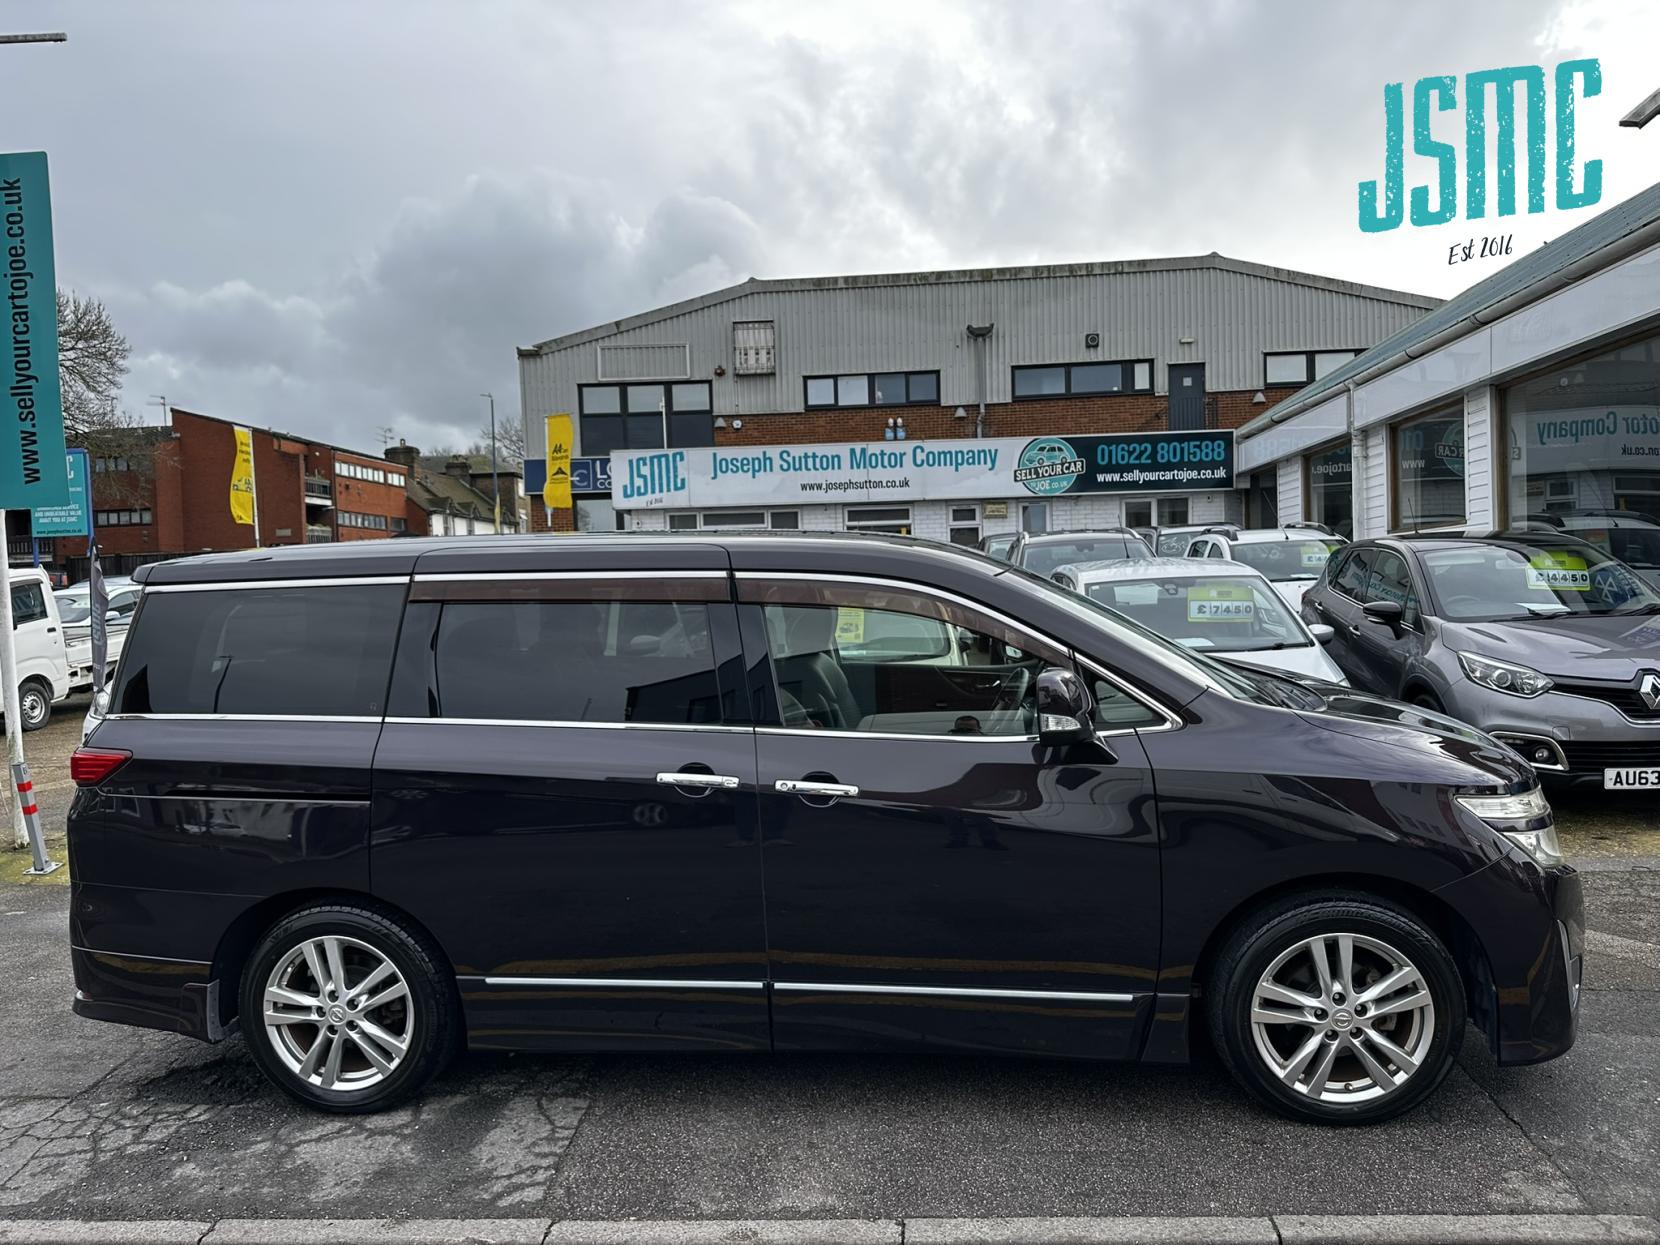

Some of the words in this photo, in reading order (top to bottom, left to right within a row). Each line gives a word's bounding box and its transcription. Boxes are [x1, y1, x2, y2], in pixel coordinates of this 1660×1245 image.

[3, 177, 41, 485] www.sellyourcartojoe.co.uk
[711, 452, 774, 480] Joseph
[779, 450, 841, 472] Sutton
[849, 447, 906, 470] Motor
[912, 444, 998, 472] Company
[1096, 443, 1152, 465] 01622
[1156, 440, 1225, 463] 801588
[622, 450, 686, 499] JSMC
[1016, 469, 1037, 481] SELL
[1038, 465, 1062, 477] YOUR
[1063, 461, 1082, 473] CAR
[1096, 466, 1227, 484] www.sellyourcartojoe.co.uk
[800, 477, 910, 493] www.josephsutton.co.uk
[1035, 480, 1050, 491] JOE
[1613, 770, 1660, 786] AU63
